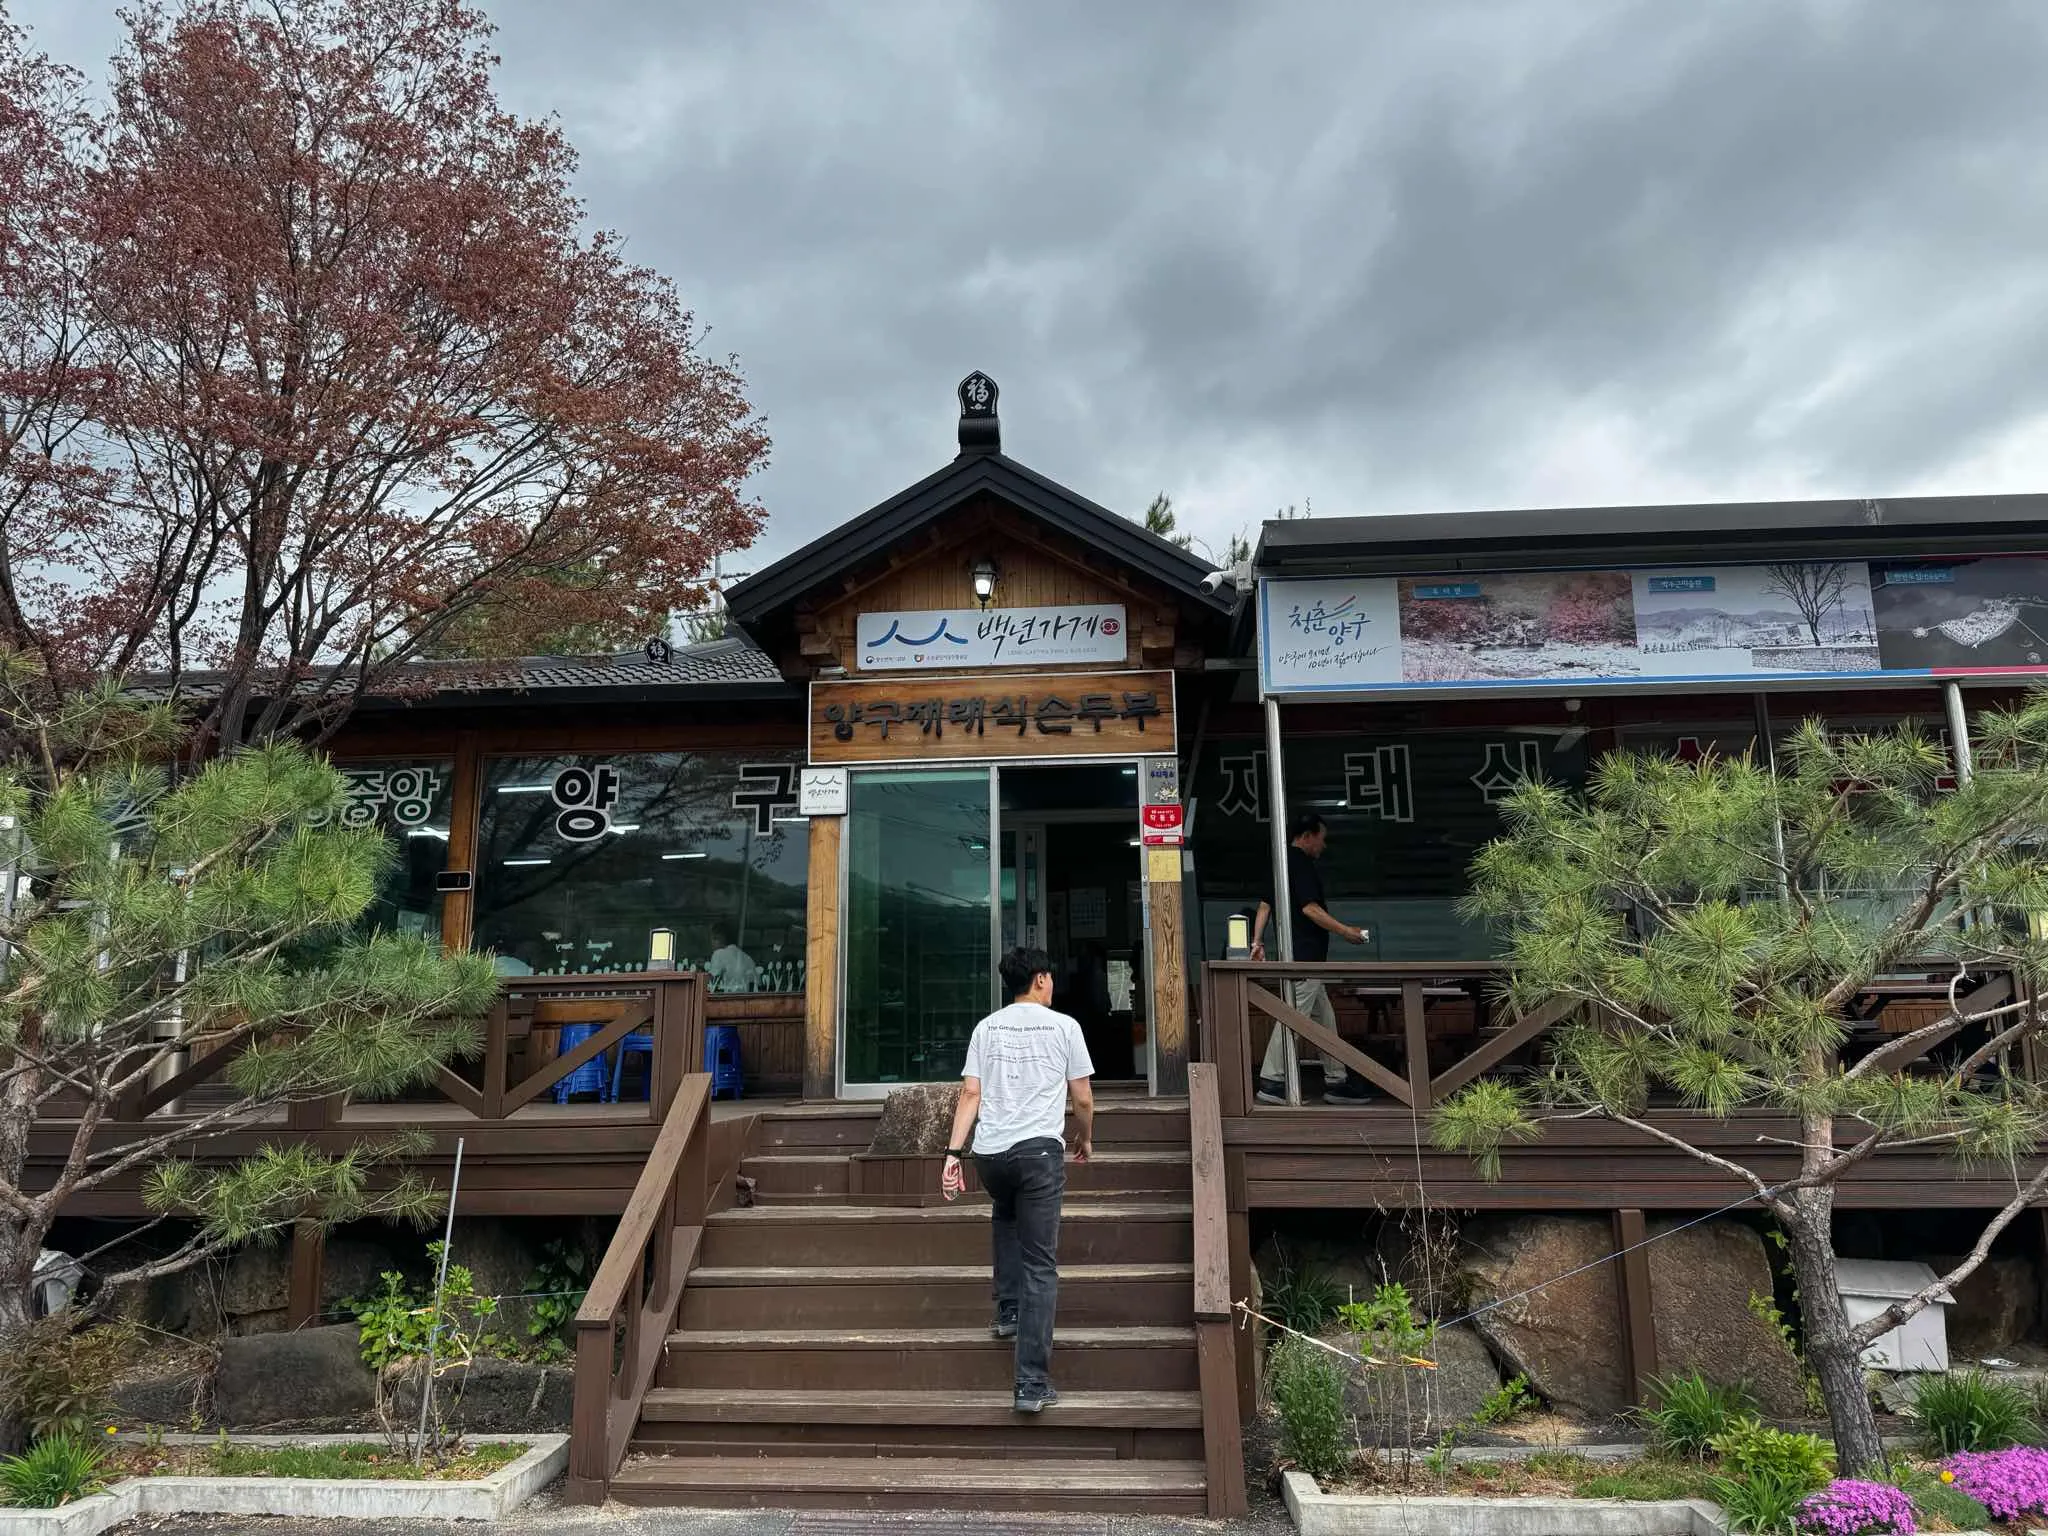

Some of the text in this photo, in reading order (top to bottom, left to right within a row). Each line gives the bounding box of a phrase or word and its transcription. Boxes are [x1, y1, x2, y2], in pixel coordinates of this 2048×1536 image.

[967, 378, 989, 403] 福
[1289, 600, 1327, 634] 청춘
[1328, 612, 1372, 646] 양구
[976, 614, 1100, 660] 백년가게
